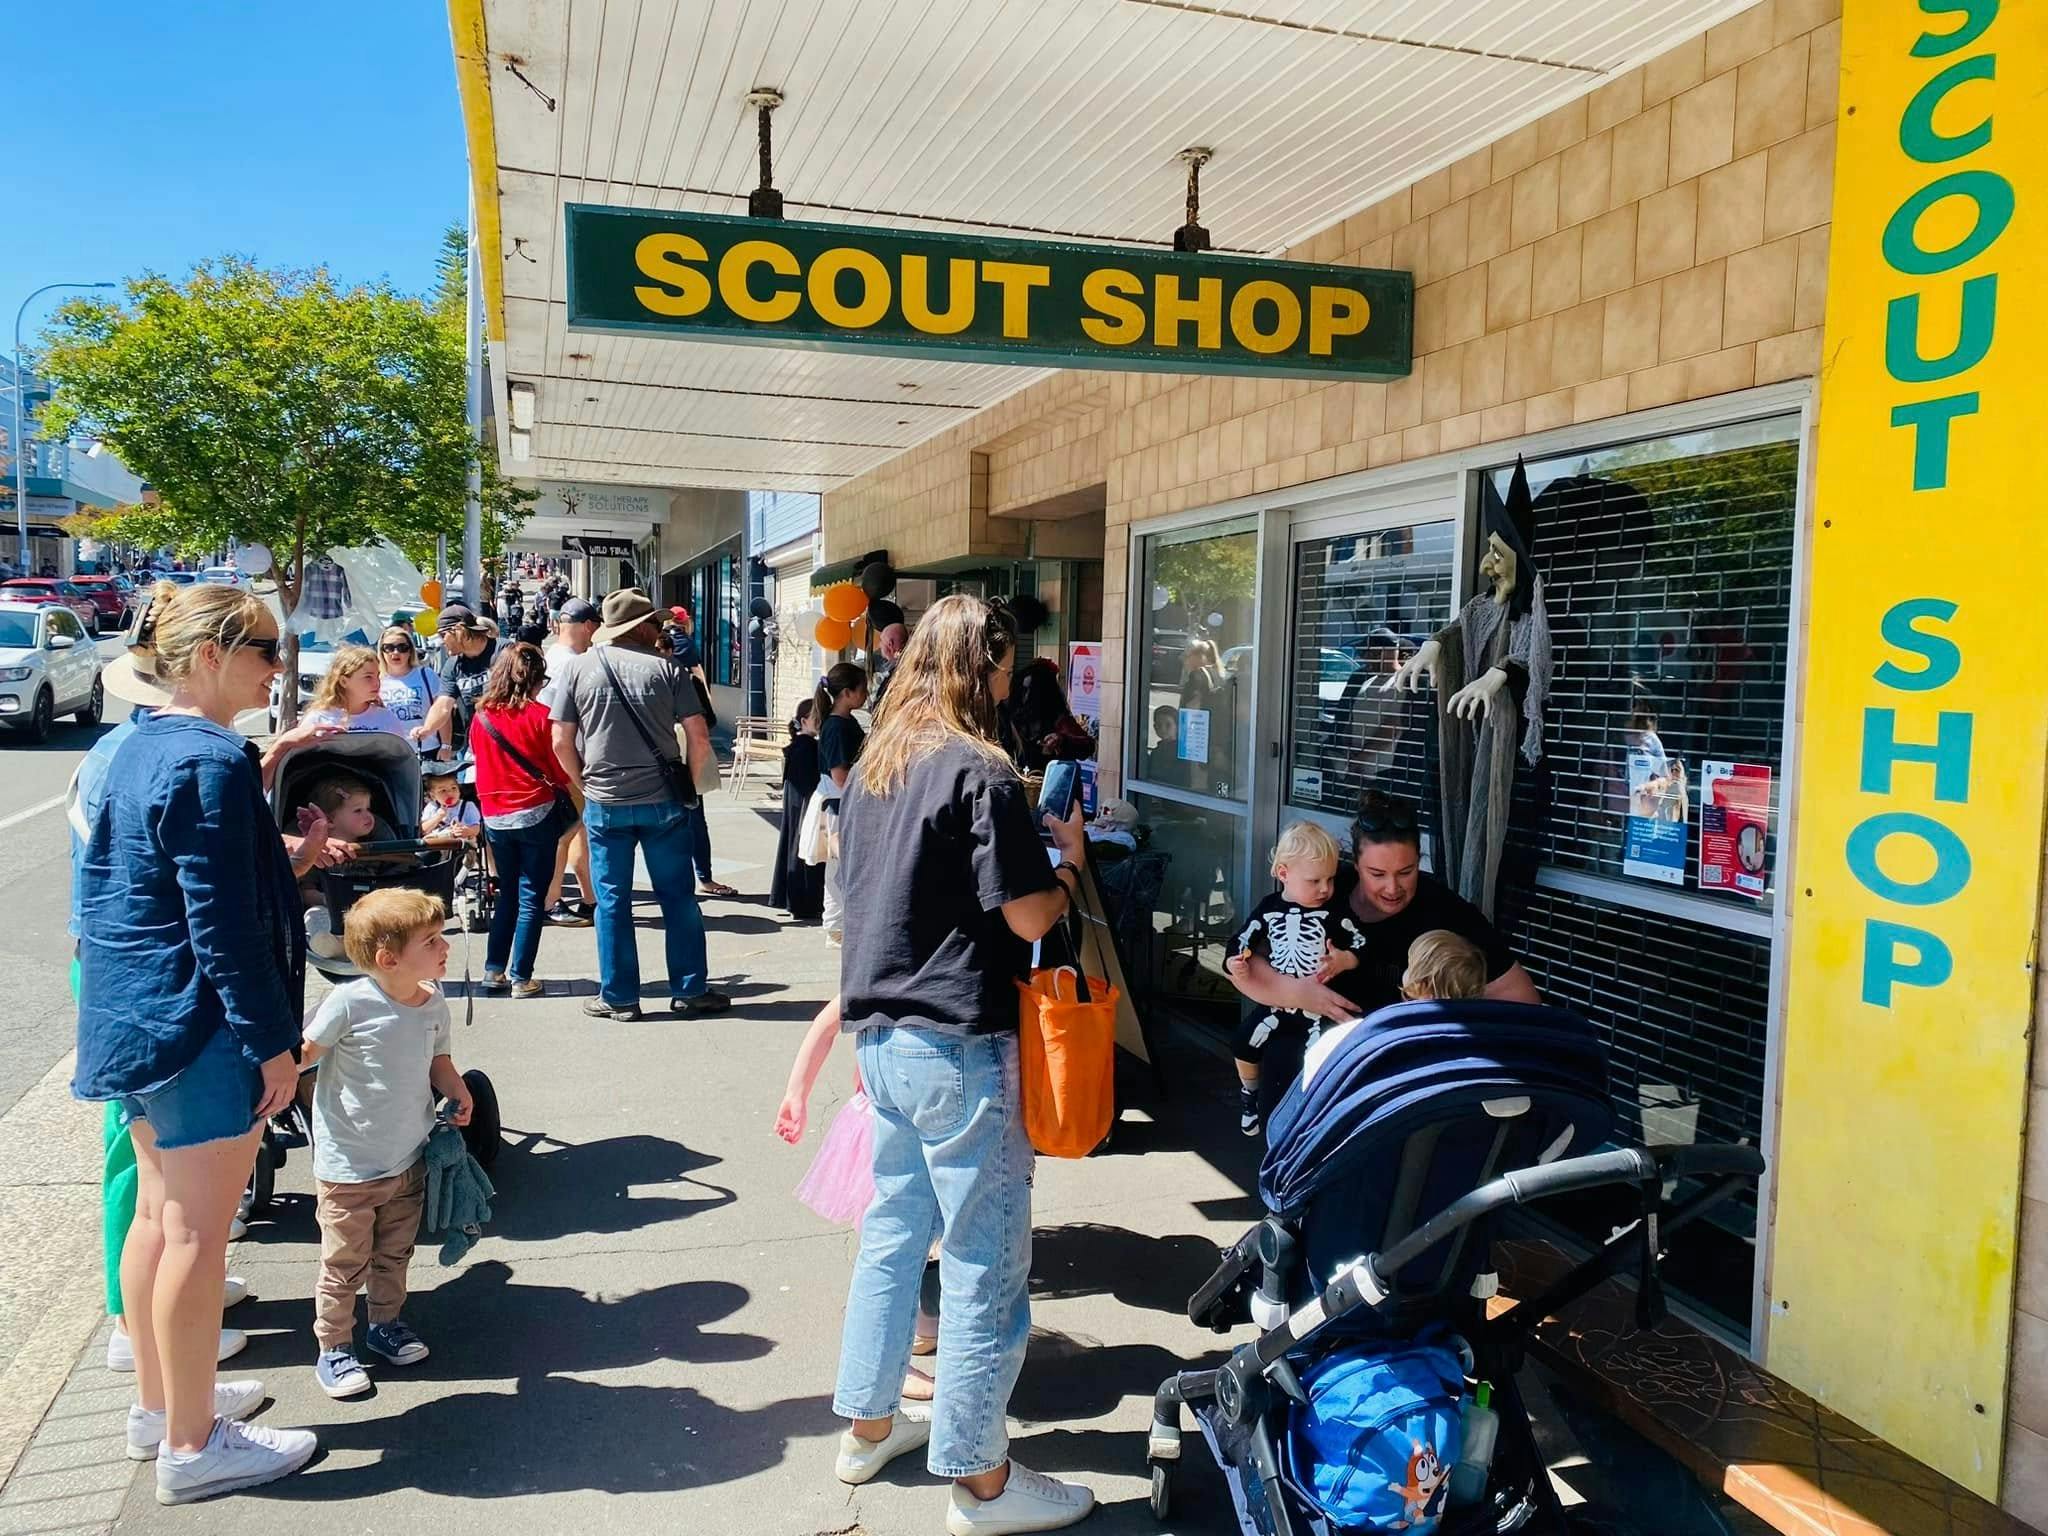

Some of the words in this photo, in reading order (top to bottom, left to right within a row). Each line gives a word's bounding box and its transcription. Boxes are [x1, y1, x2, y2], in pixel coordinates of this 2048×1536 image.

[634, 232, 1051, 339] SCOUT
[1080, 268, 1371, 355] SHOP
[588, 493, 609, 502] REAL
[611, 494, 649, 504] THERAPY
[588, 501, 649, 512] SOLUTIONS
[1846, 597, 1974, 1009] SHOP
